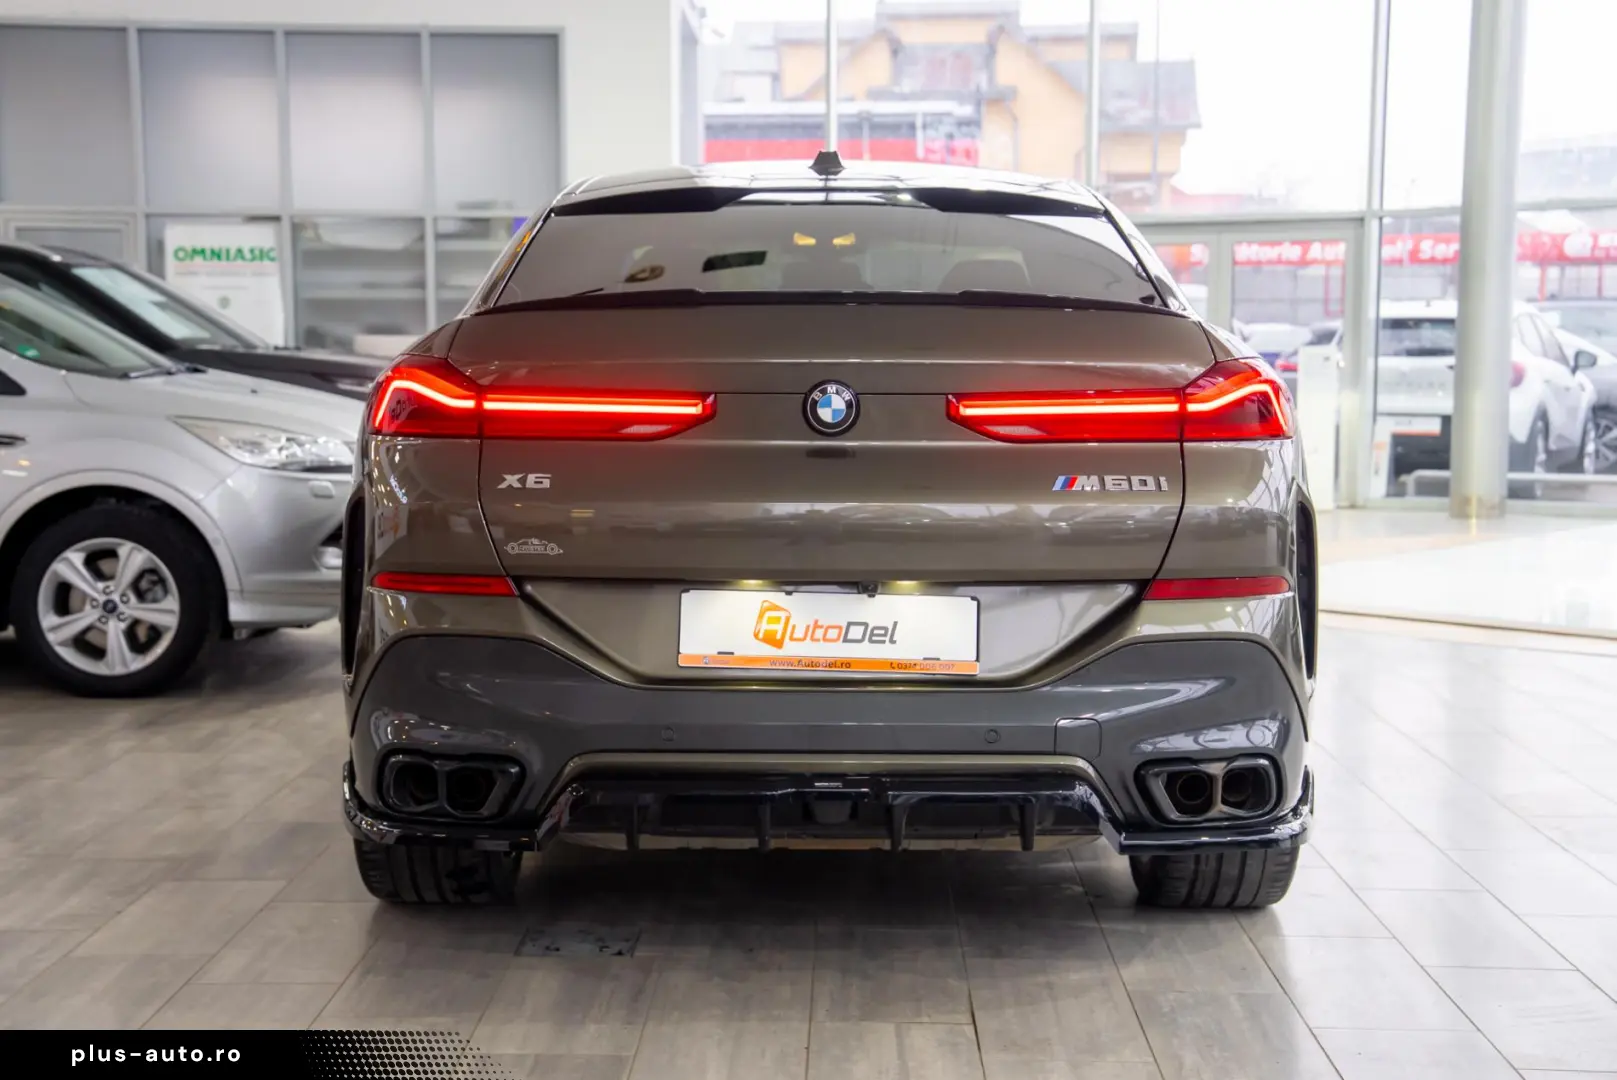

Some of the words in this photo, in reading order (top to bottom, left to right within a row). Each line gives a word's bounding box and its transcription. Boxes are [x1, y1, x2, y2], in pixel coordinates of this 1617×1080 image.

[813, 386, 851, 401] BMW
[497, 473, 552, 489] X6
[756, 604, 899, 646] AutoDel
[769, 659, 852, 669] www.Autodel.ro
